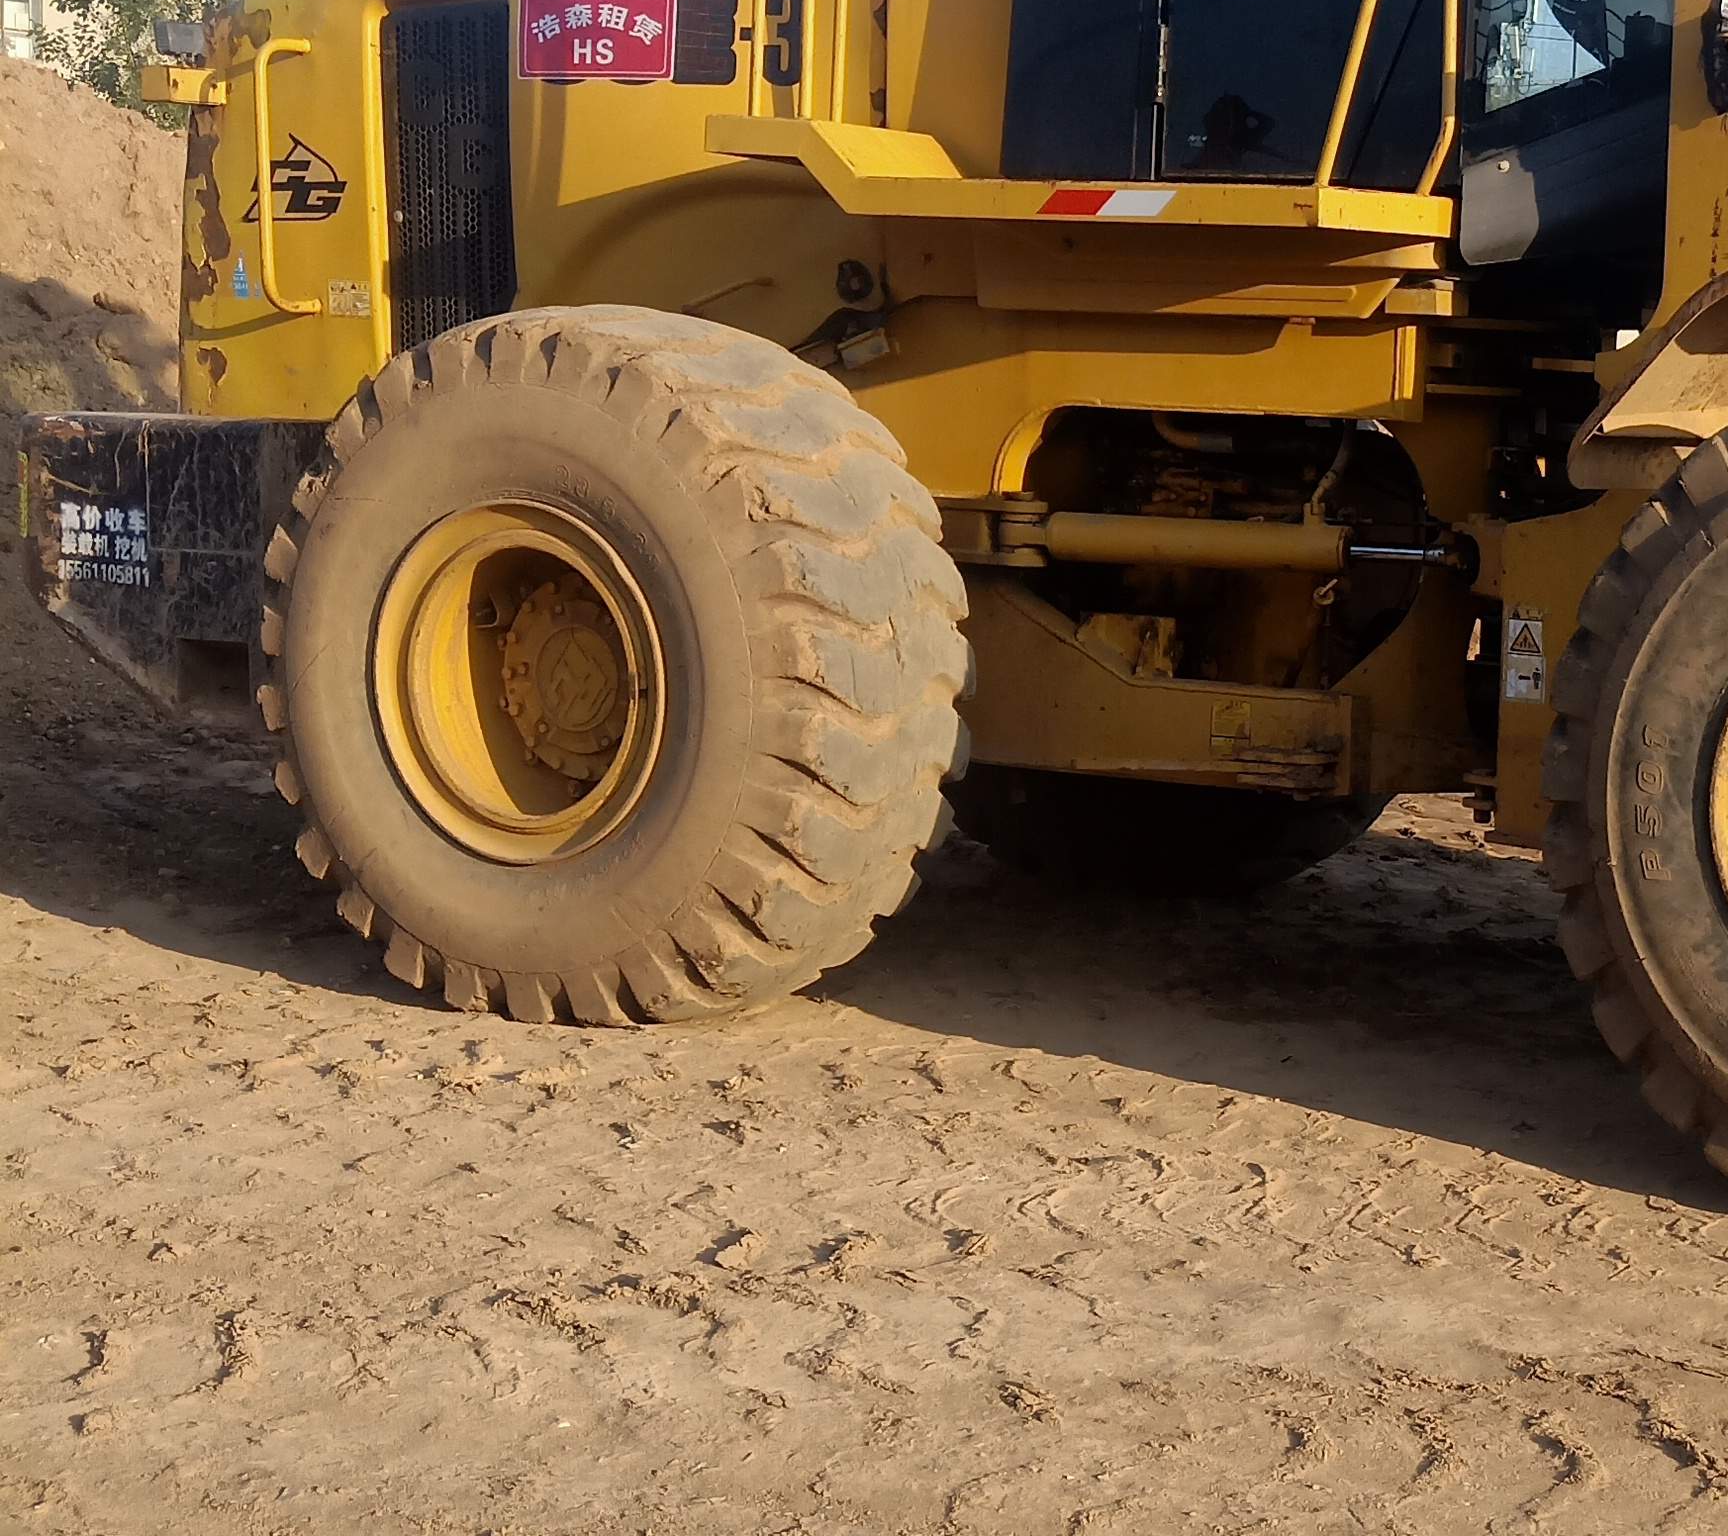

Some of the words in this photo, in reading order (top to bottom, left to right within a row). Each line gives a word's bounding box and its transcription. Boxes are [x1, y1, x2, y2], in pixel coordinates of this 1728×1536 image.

[530, 3, 664, 46] 浩森租赁
[572, 38, 615, 65] HS
[114, 536, 148, 562] 挖机
[1634, 724, 1672, 881] P501
